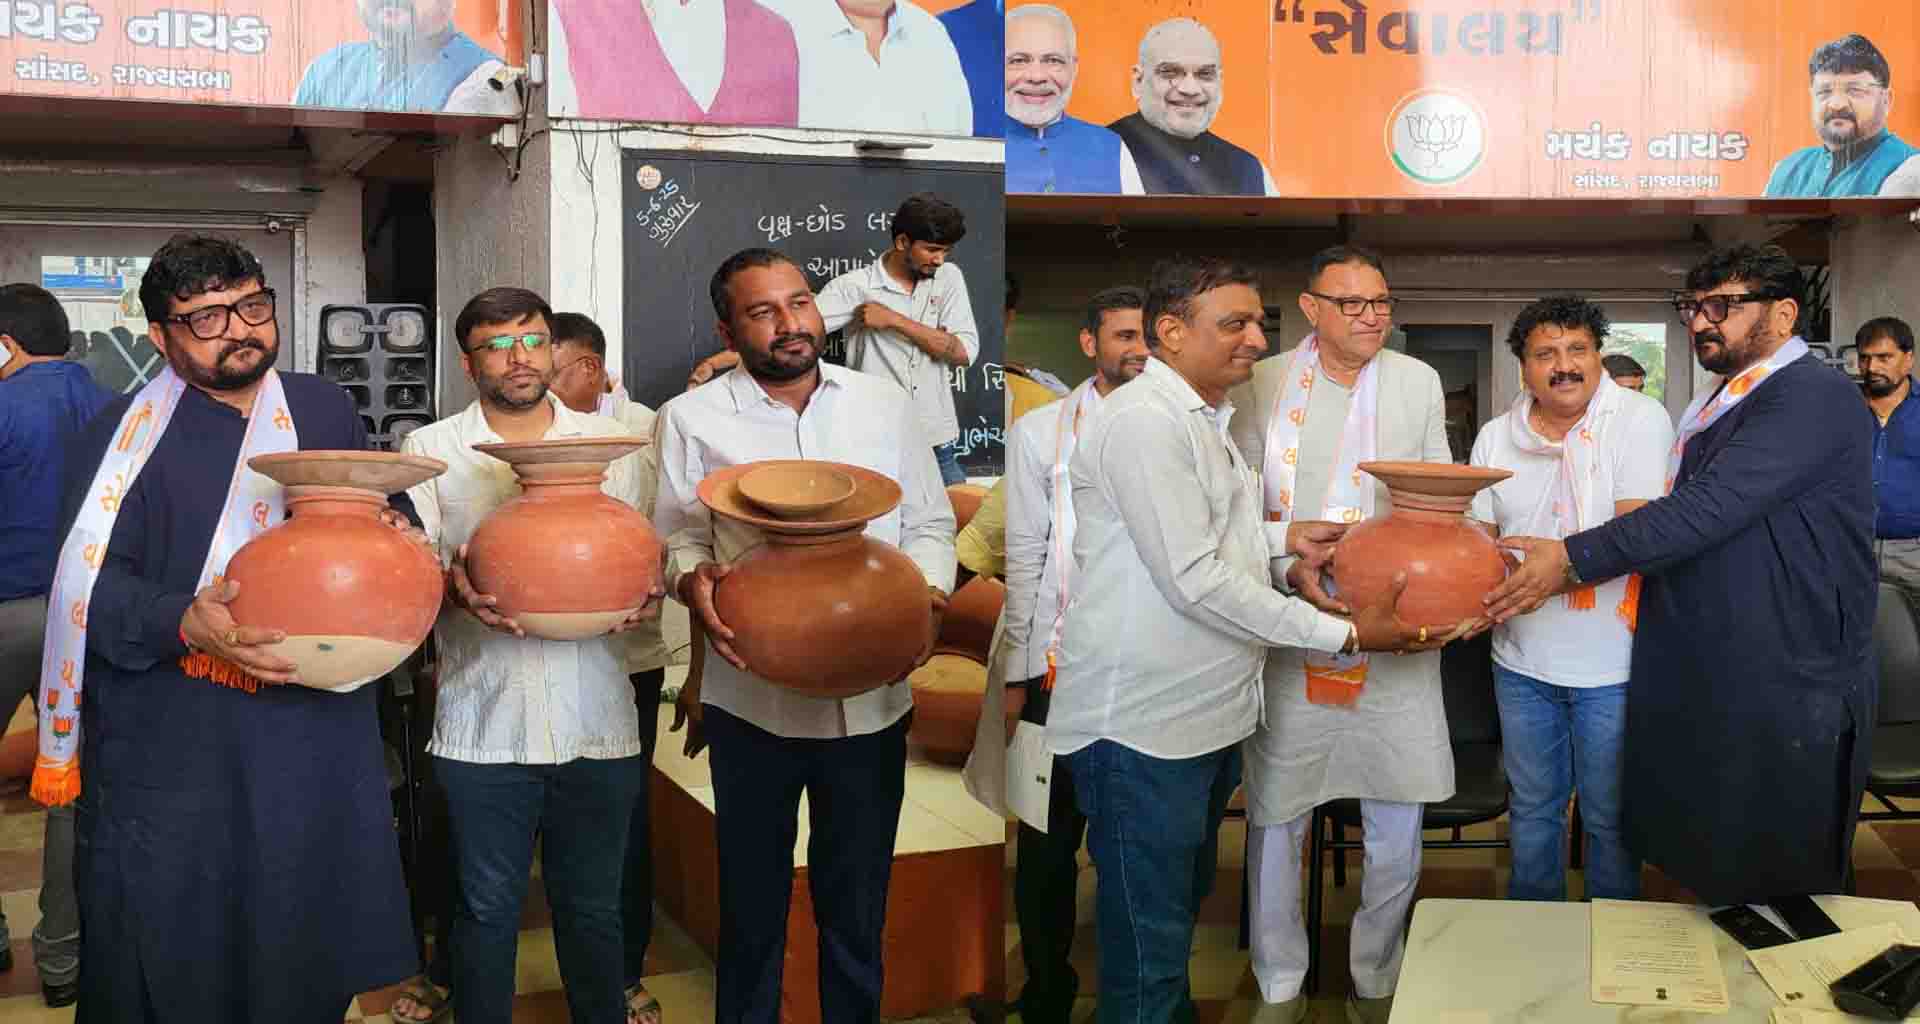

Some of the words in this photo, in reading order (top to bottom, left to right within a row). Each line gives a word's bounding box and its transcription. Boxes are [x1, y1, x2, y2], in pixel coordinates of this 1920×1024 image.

[126, 9, 271, 54] નાયક
[112, 63, 232, 89] રાજ્યસભા
[1546, 121, 1631, 160] મયંક
[1648, 131, 1750, 160] નાયક
